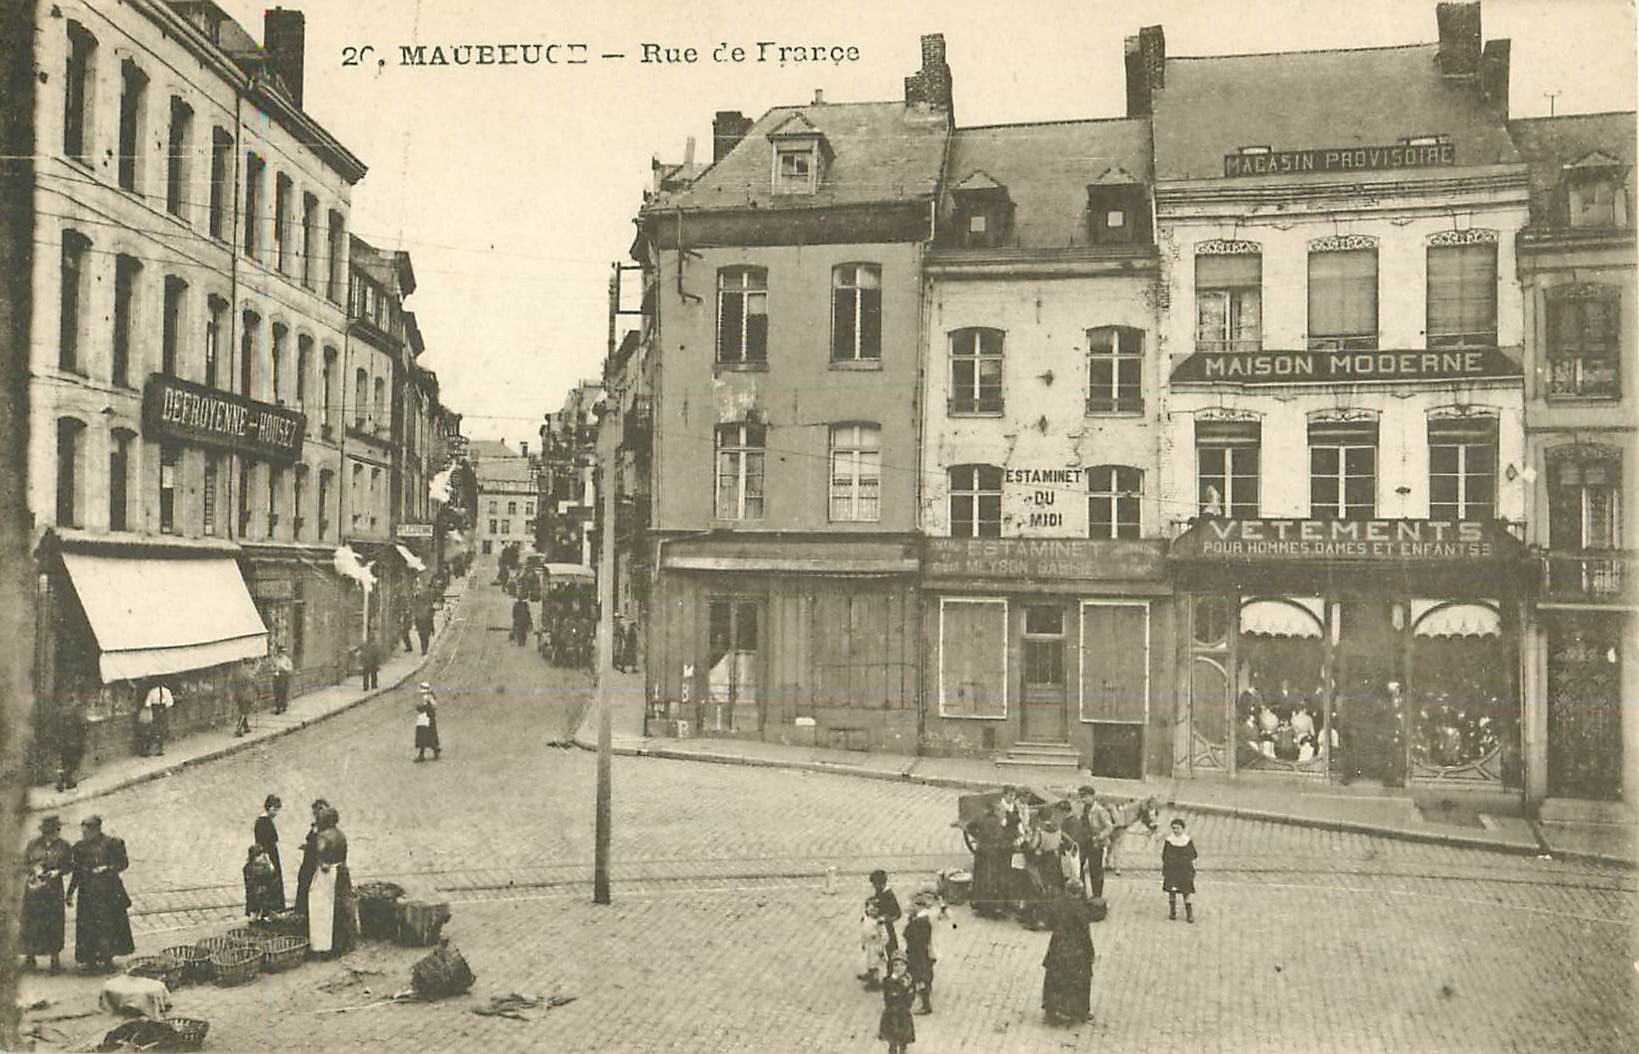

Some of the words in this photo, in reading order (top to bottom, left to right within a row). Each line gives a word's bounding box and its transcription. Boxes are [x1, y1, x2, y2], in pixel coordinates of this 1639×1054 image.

[1226, 153, 1314, 174] MAGASIN
[1325, 146, 1453, 168] PROVISOIRE
[1205, 355, 1314, 377] MAISON
[1329, 352, 1484, 375] MODERNE
[1005, 469, 1083, 484] ESTAMINET
[1034, 491, 1055, 506] DU
[1029, 512, 1063, 527] MIDI
[1208, 520, 1484, 541] VETEMENTS
[967, 540, 1104, 557] ESTAMINET
[1203, 541, 1243, 554] POUR
[1373, 542, 1395, 555] ET
